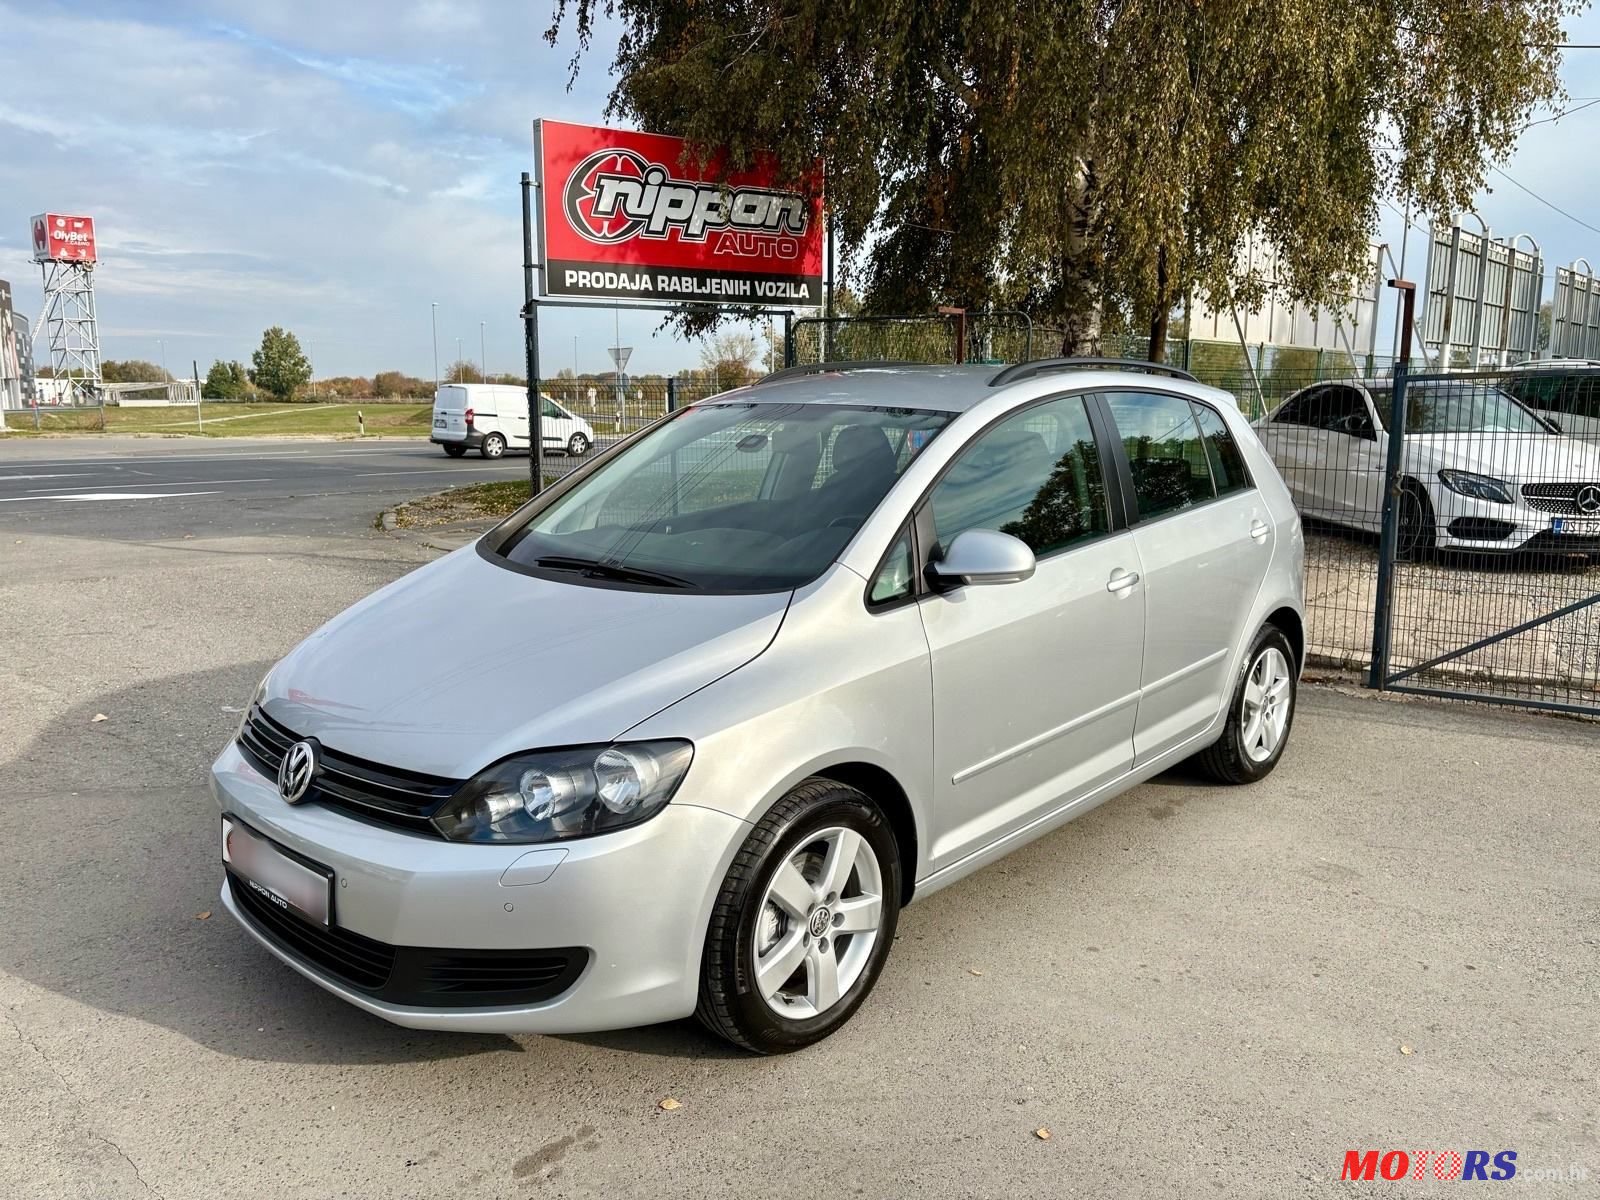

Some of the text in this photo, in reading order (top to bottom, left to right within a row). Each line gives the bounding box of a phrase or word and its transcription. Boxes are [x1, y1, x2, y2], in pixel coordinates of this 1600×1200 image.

[596, 166, 805, 237] nippon
[53, 230, 88, 242] OlyBet
[714, 233, 799, 260] AUTO
[565, 270, 810, 299] PRODAJA RABLJENIH VOZILA
[270, 894, 288, 909] AUTO
